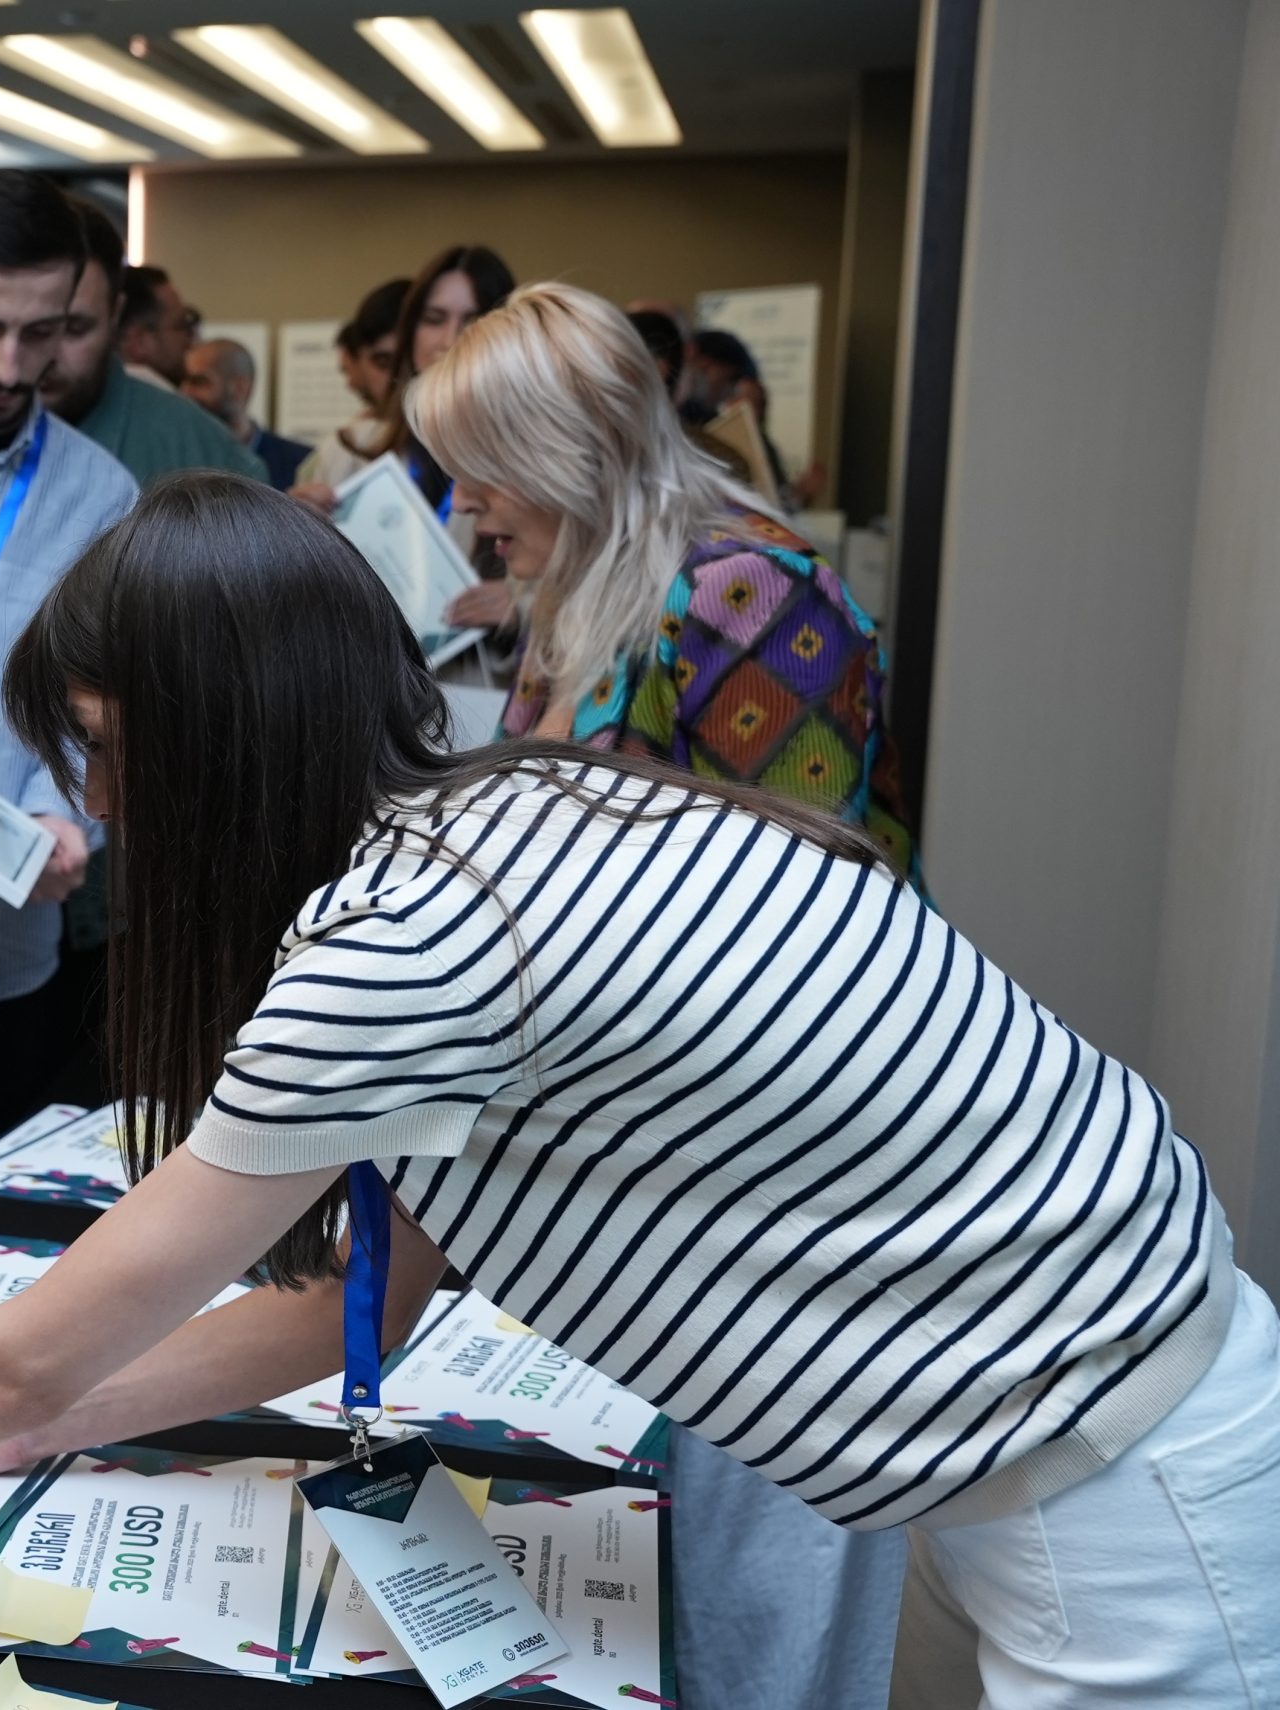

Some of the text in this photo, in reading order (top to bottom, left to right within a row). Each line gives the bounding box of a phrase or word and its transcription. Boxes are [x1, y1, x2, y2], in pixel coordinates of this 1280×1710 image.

[509, 1372, 557, 1400] 300
[533, 1345, 574, 1371] US
[20, 1512, 76, 1572] ვაუჩერი
[108, 1505, 164, 1595] 300 USD
[592, 1618, 606, 1657] xgate.dental
[456, 1660, 486, 1678] XGATE
